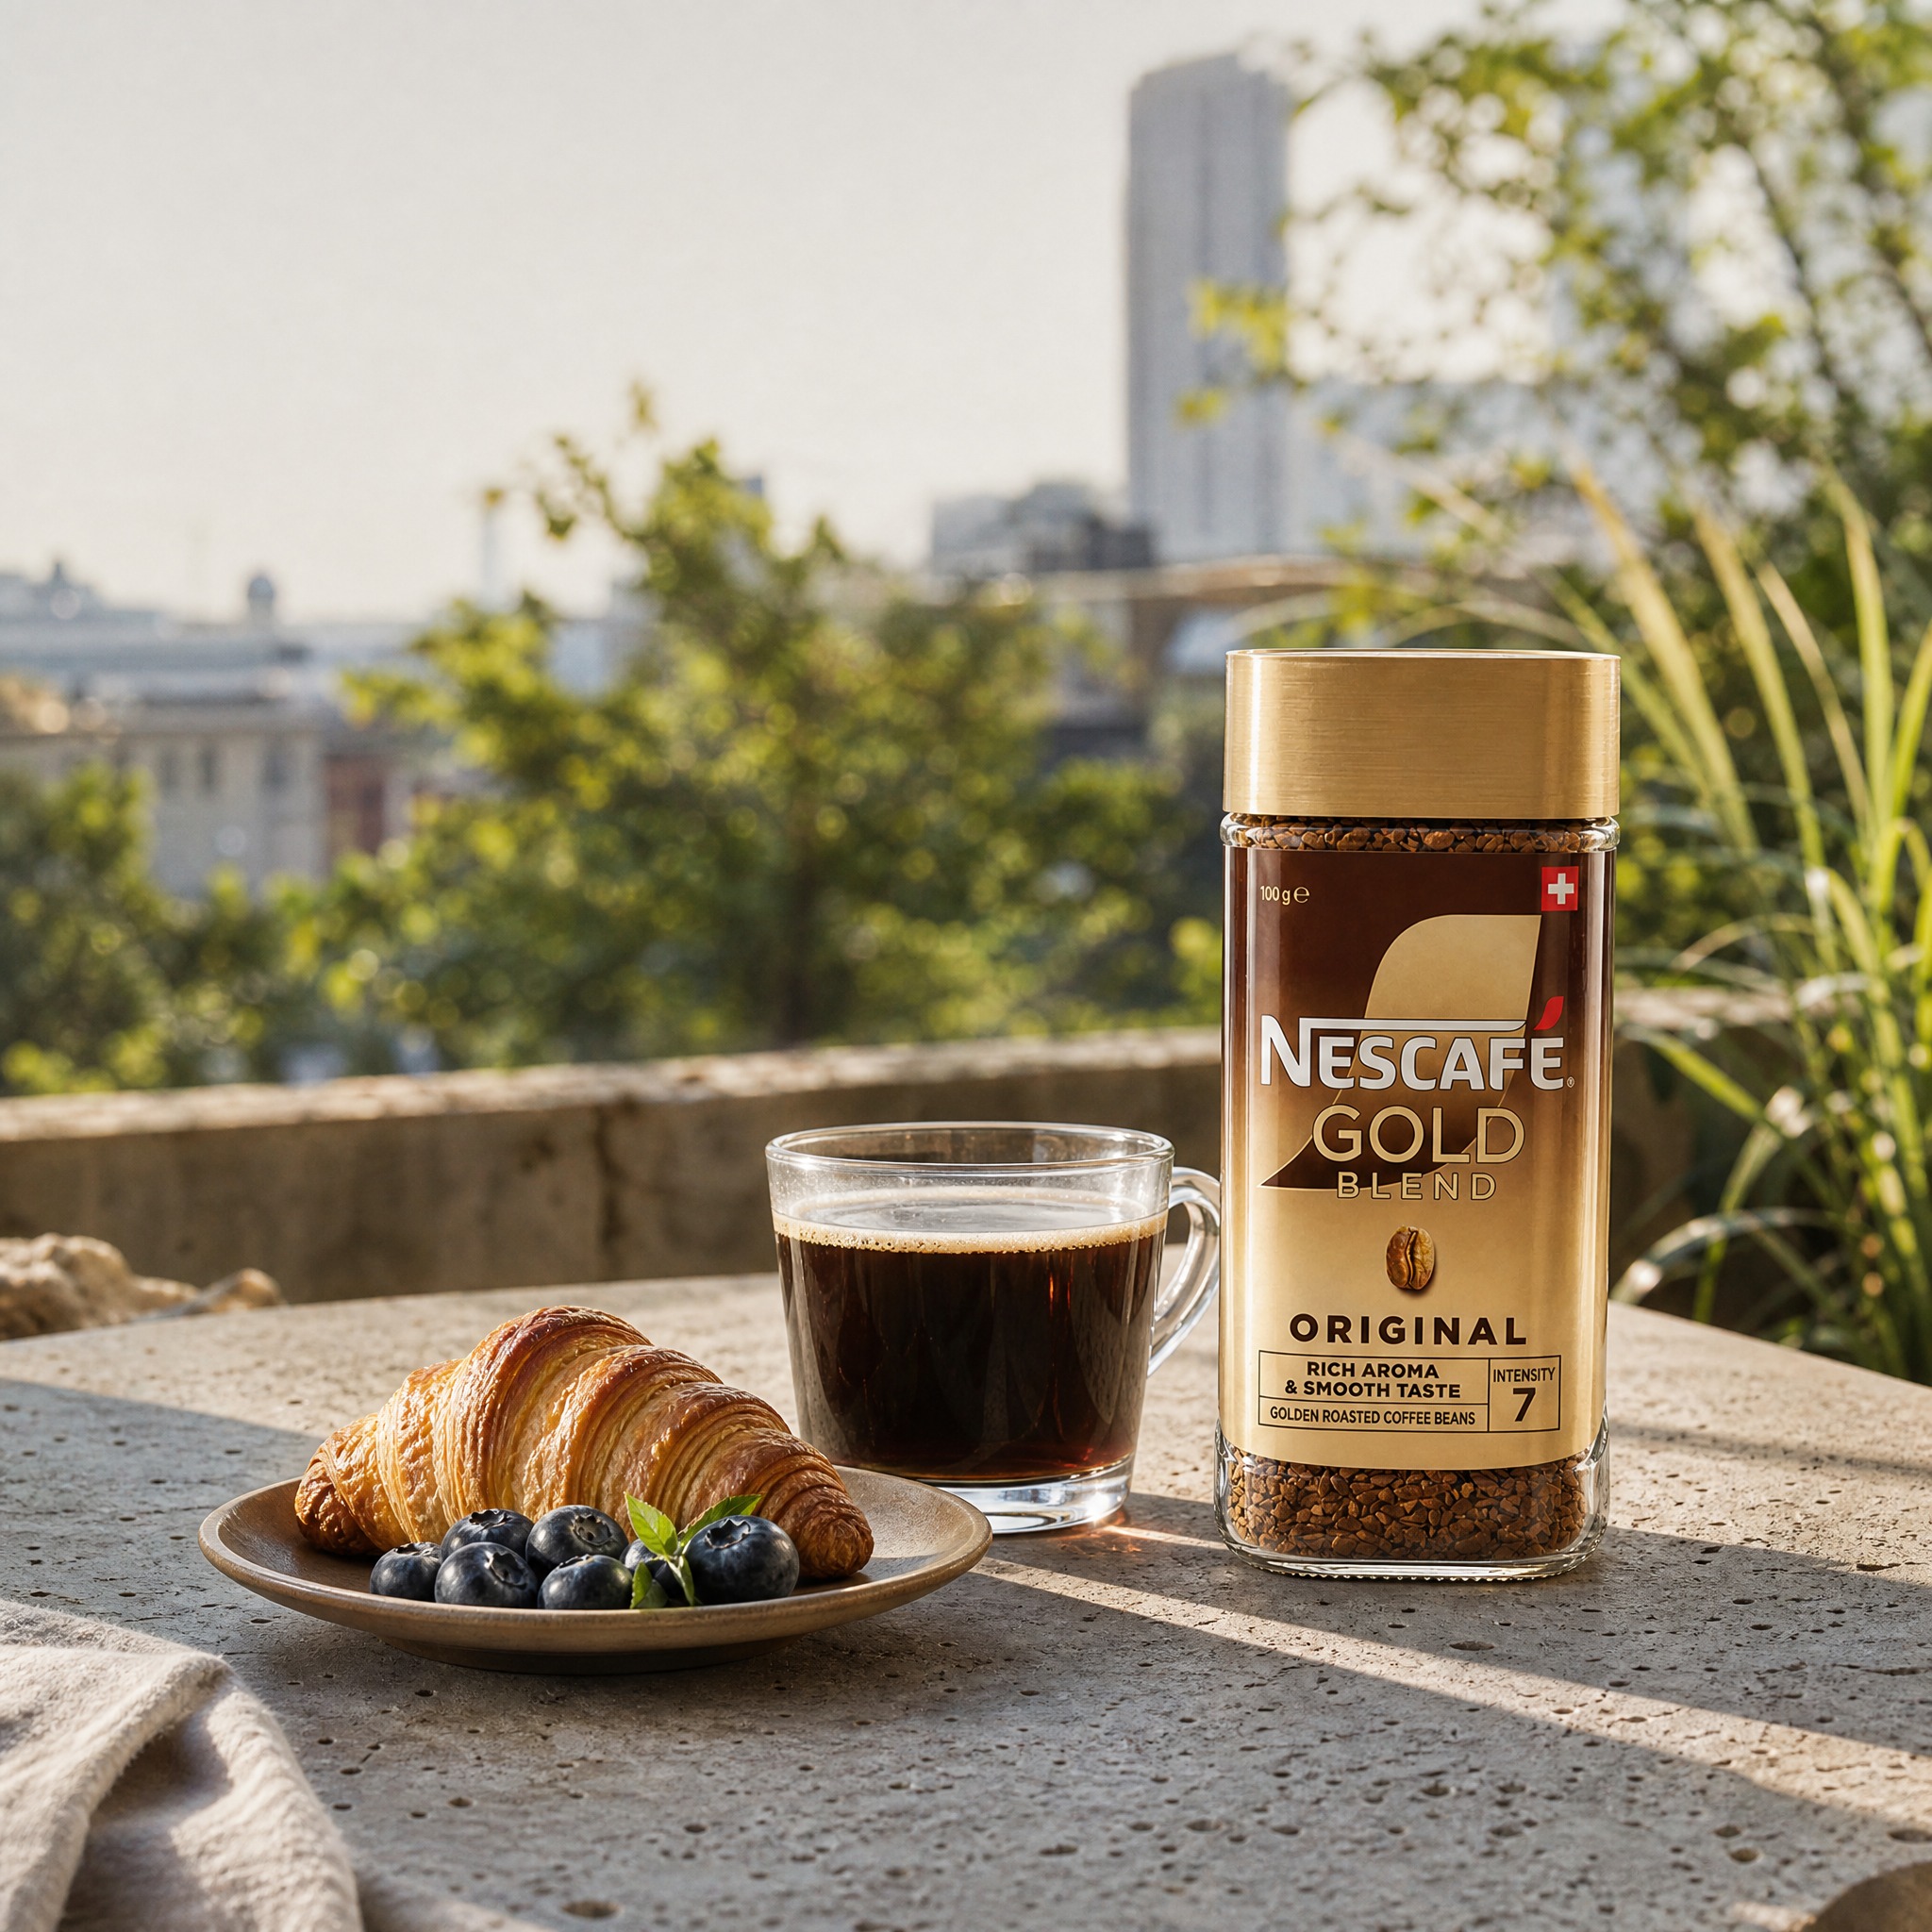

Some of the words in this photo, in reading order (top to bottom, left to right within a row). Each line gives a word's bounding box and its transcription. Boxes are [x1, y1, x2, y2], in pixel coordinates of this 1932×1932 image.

[1312, 1105, 1525, 1164] GOLD
[1337, 1172, 1496, 1200] BLEND
[1290, 1313, 1527, 1345] ORIGINAL
[1307, 1361, 1356, 1377] RICH
[1362, 1363, 1440, 1379] AROMA
[1492, 1367, 1556, 1383] INTENSITY
[1285, 1380, 1297, 1394] &
[1304, 1382, 1390, 1397] SMOOTH
[1396, 1383, 1461, 1398] TASTE
[1270, 1406, 1319, 1423] GOLDEN
[1322, 1408, 1380, 1424] ROASTED
[1383, 1410, 1432, 1425] COFFEE
[1434, 1411, 1475, 1425] BEANS
[1512, 1388, 1536, 1423] 7
